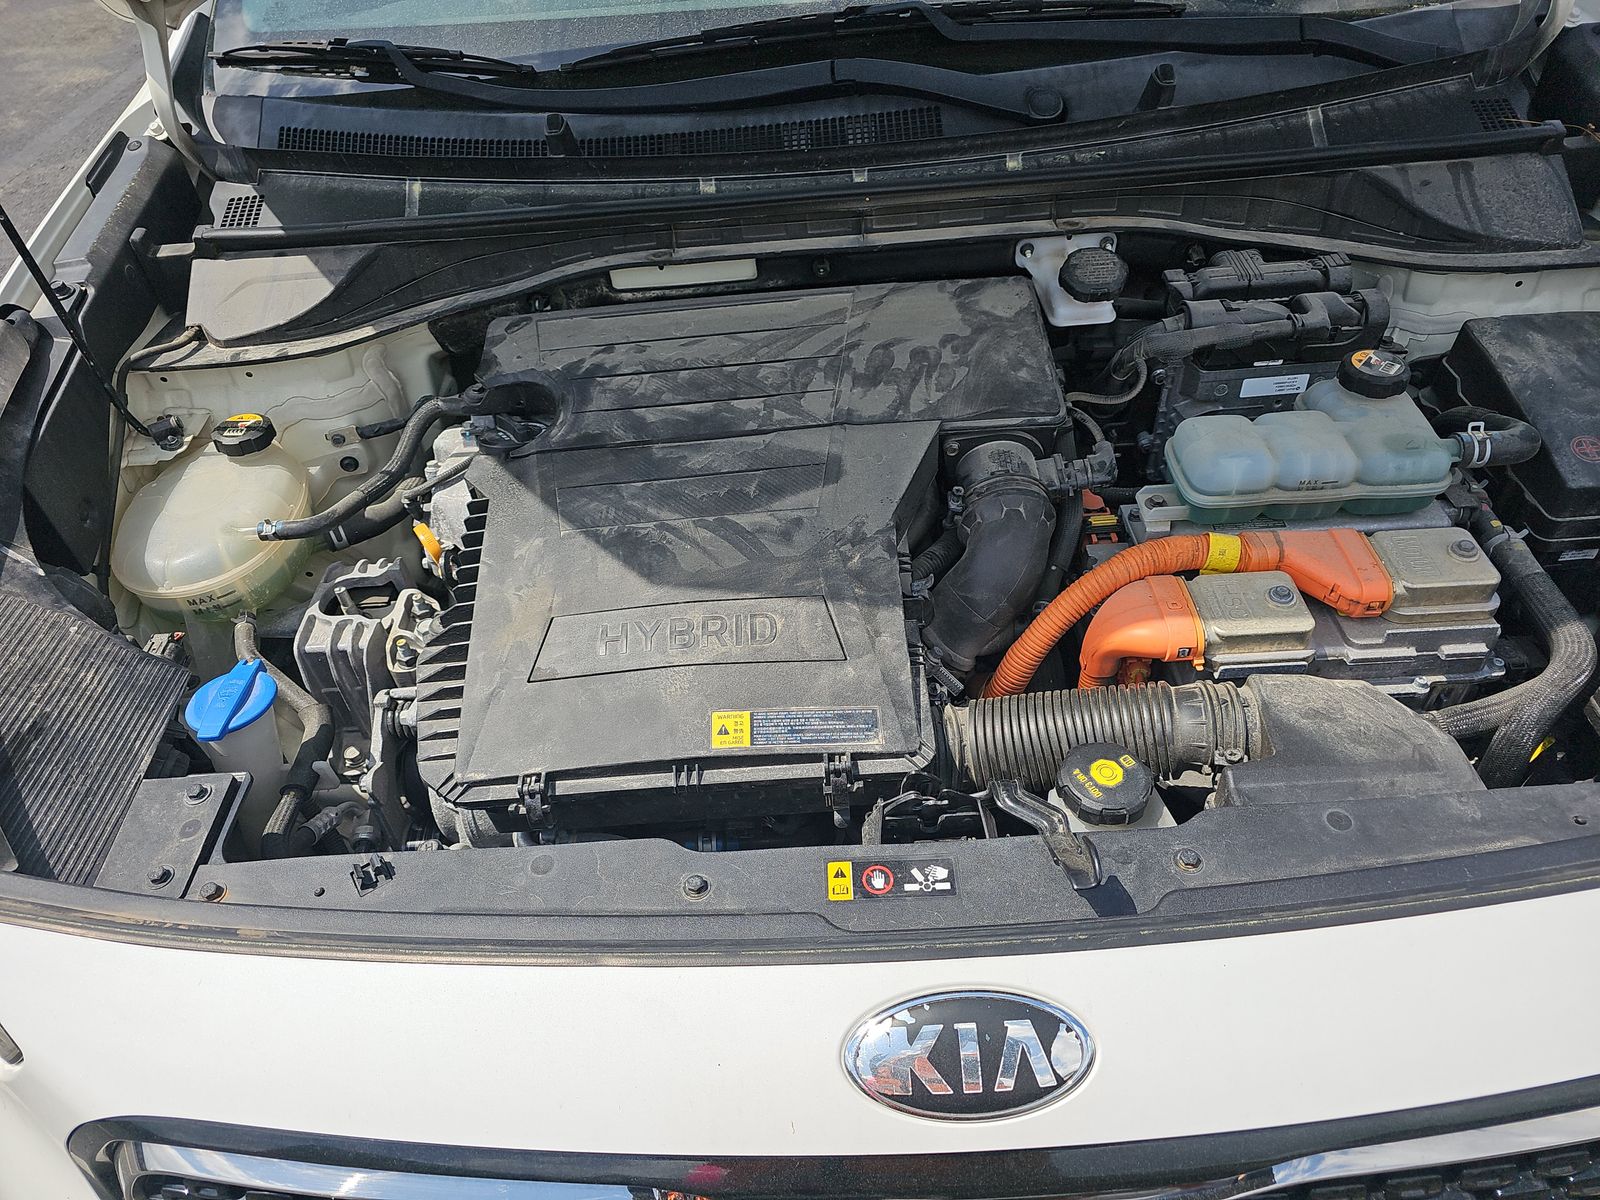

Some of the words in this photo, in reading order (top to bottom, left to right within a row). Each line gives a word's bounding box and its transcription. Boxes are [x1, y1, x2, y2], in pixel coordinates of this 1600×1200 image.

[186, 594, 216, 606] MAX
[599, 612, 778, 656] HYBRID
[890, 1019, 1057, 1095] KIA
